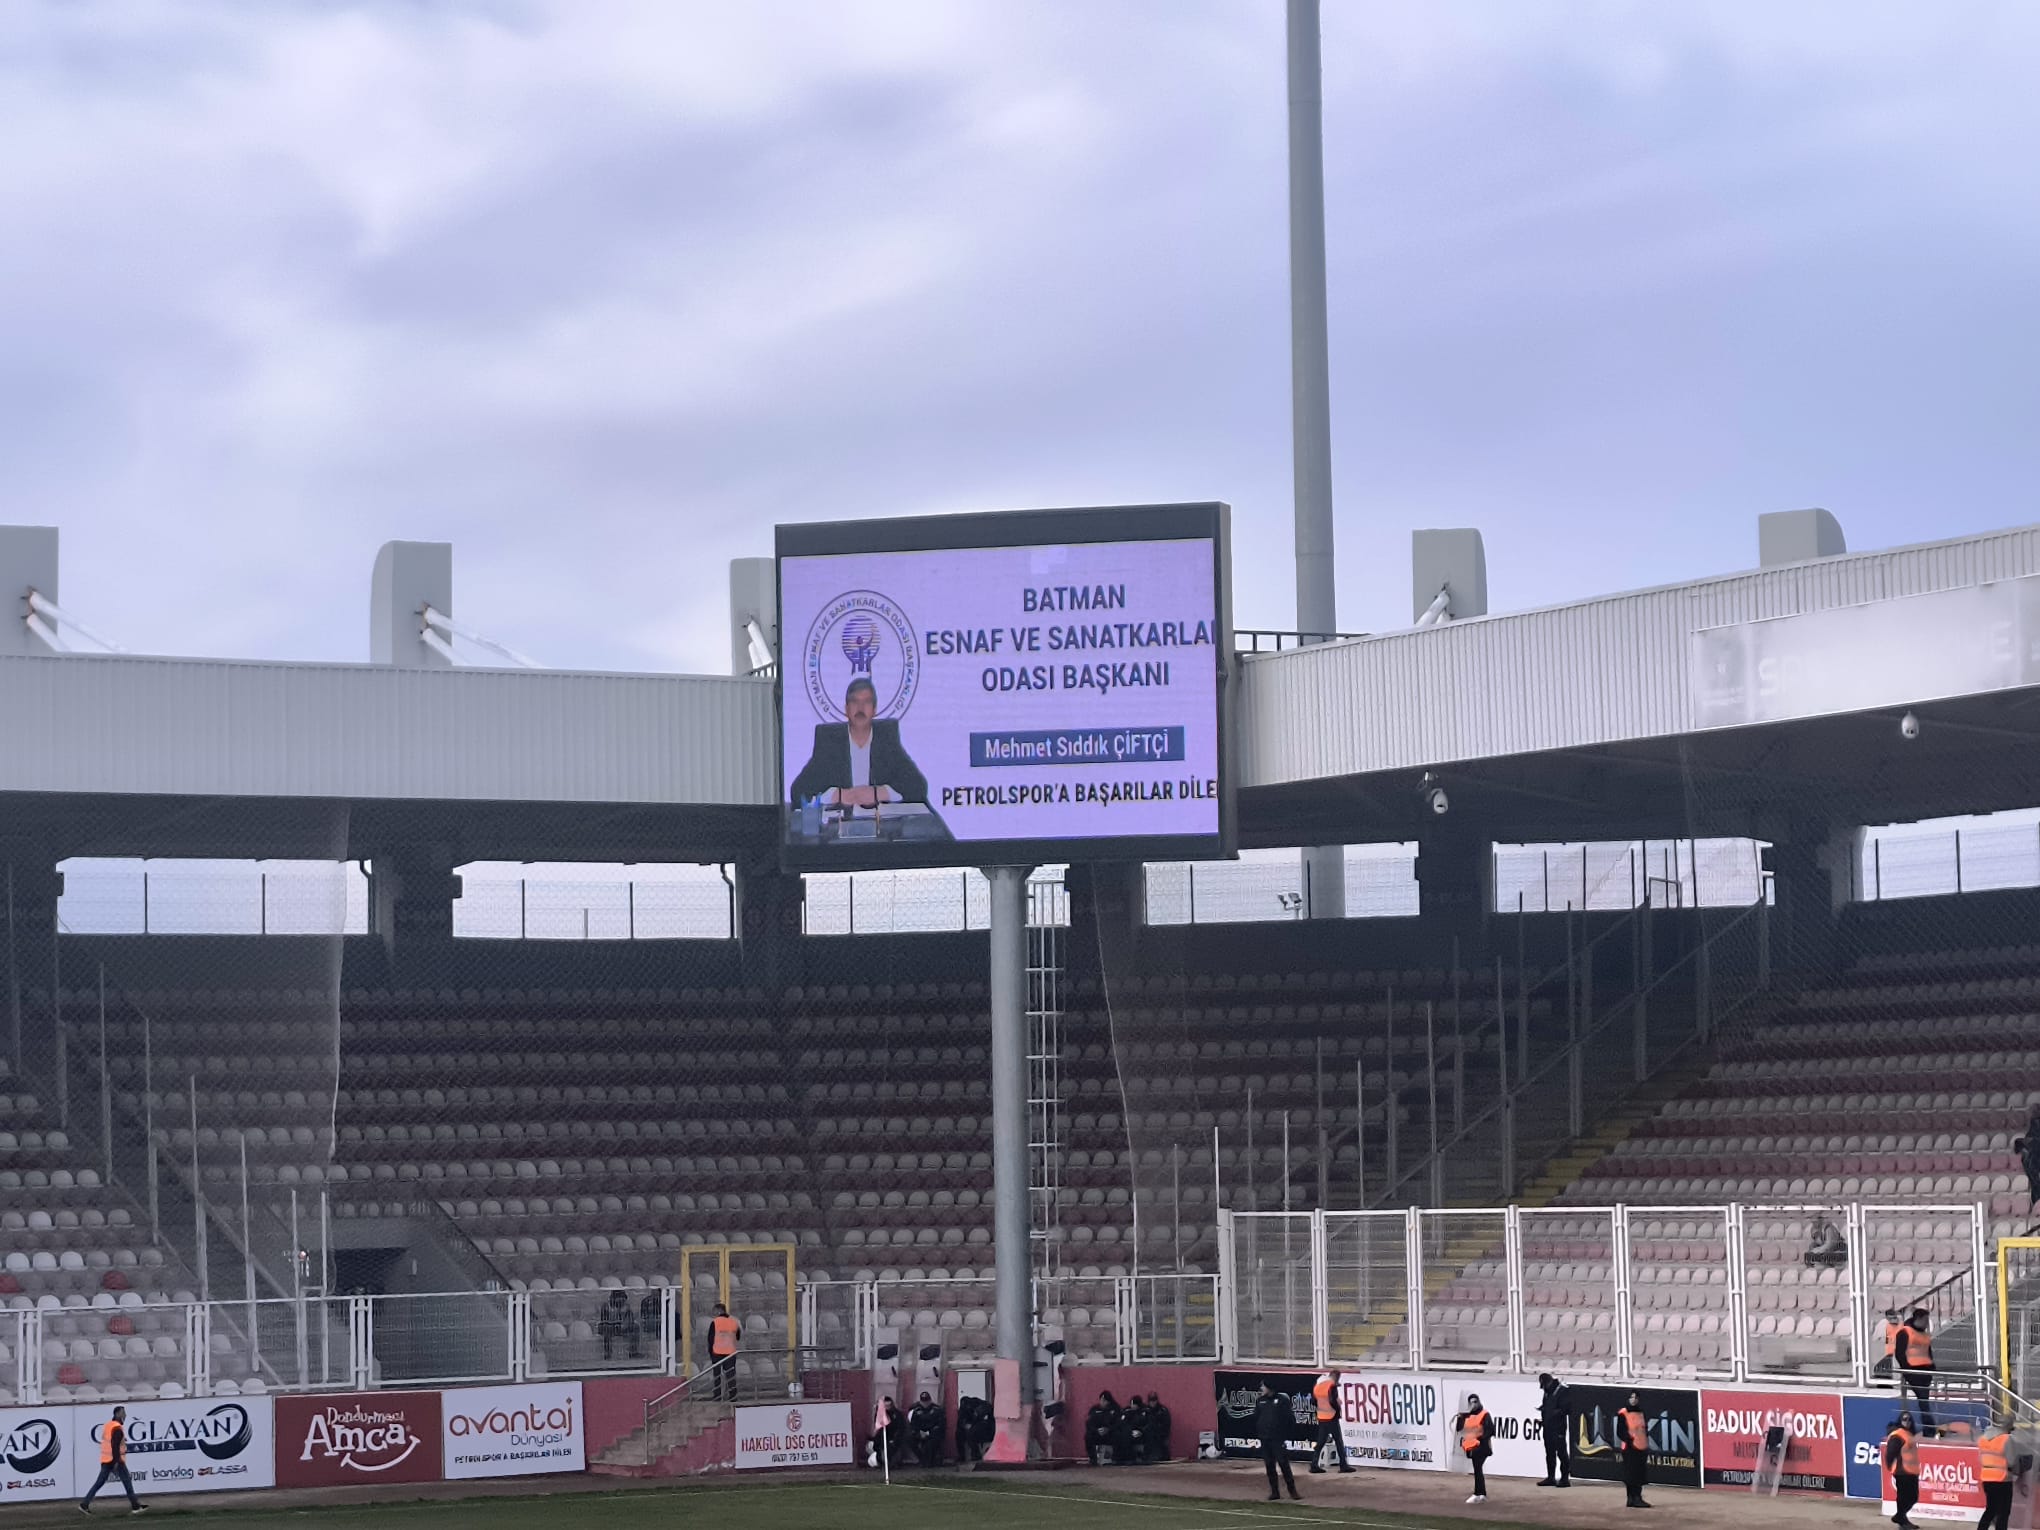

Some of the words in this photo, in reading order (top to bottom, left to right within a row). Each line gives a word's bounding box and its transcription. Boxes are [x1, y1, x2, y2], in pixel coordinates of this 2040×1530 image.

[1023, 584, 1126, 612] BATMAN
[818, 615, 831, 631] VE
[890, 612, 911, 644] ODASI
[926, 629, 1004, 655] ESNAF
[1011, 627, 1040, 652] VE
[1048, 619, 1216, 650] SANATKARLA
[982, 665, 1055, 692] ODASI
[1062, 661, 1170, 694] BAŞKANI
[985, 737, 1052, 759] Mehmet
[1057, 734, 1109, 757] Sıddık
[1114, 729, 1169, 760] ÇİFTÇİ
[942, 783, 1069, 806] PETROLSPOR'A
[1075, 780, 1174, 807] BAŞARILAR
[449, 1397, 573, 1437] avantaj
[1339, 1382, 1436, 1426] ERSAGRUP
[300, 1414, 406, 1460] Amca
[1707, 1408, 1762, 1436] BADUK
[511, 1432, 563, 1447] Dünyası
[785, 1434, 805, 1450] DSG
[808, 1433, 848, 1449] CENTER
[18, 1478, 56, 1488] LASSA
